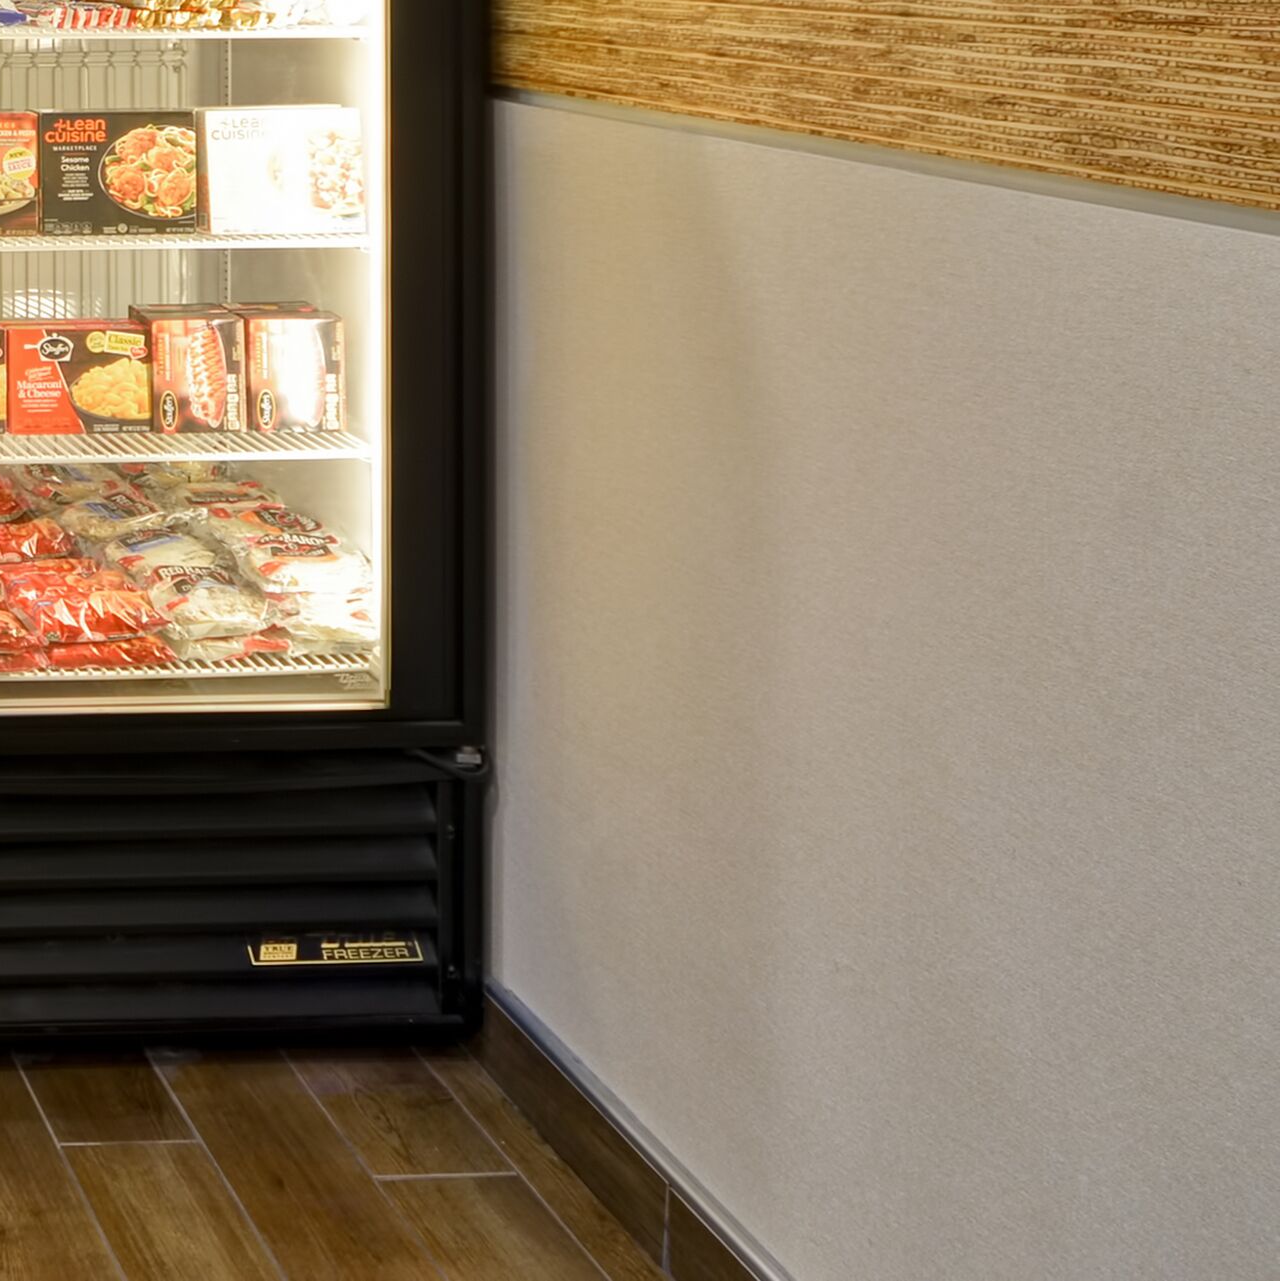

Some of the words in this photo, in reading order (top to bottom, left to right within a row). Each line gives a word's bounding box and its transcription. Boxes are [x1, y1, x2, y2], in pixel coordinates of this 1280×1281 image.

[108, 334, 142, 347] Classic
[16, 381, 62, 389] Macaroni
[18, 390, 26, 398] &
[27, 390, 61, 398] Cheese
[322, 947, 410, 960] FREEZER
